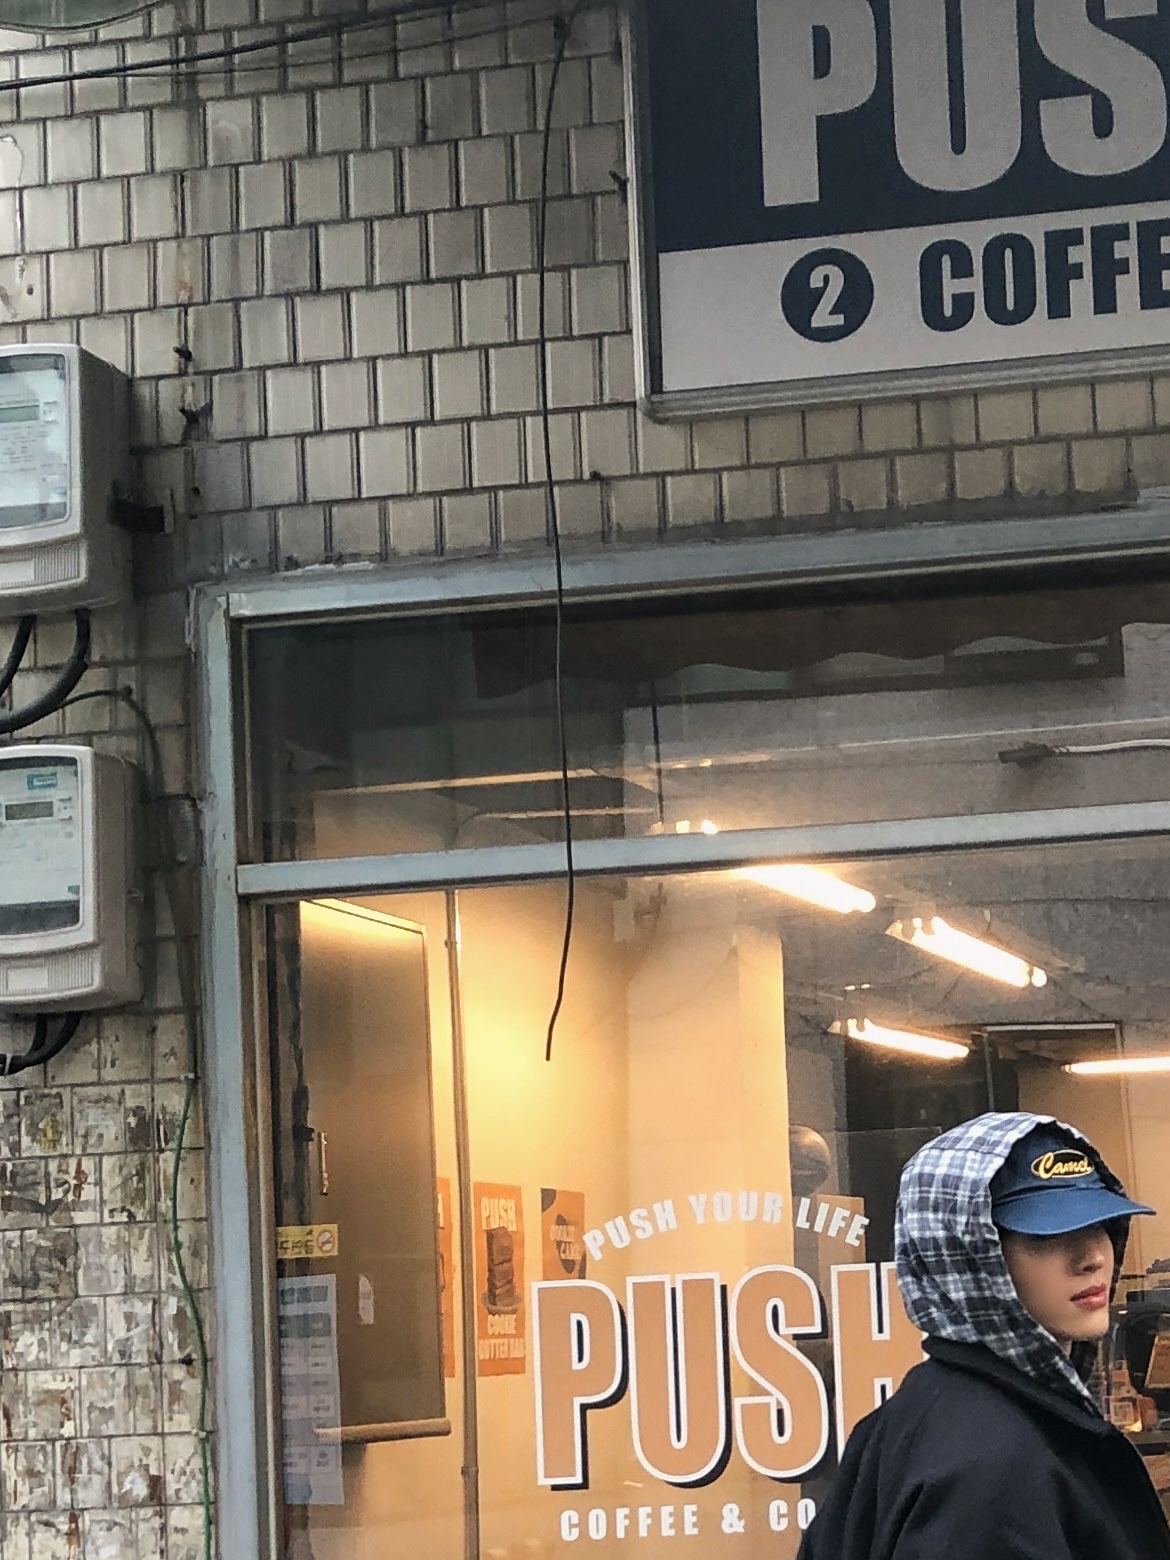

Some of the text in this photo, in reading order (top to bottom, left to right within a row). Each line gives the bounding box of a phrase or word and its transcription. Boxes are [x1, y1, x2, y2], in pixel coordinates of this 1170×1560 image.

[479, 1196, 518, 1232] PUSH
[583, 1190, 870, 1261] PUSH YOUR LIFE
[532, 1262, 929, 1488] PUSH
[560, 1502, 698, 1541] COFFEE
[721, 1503, 745, 1534] &
